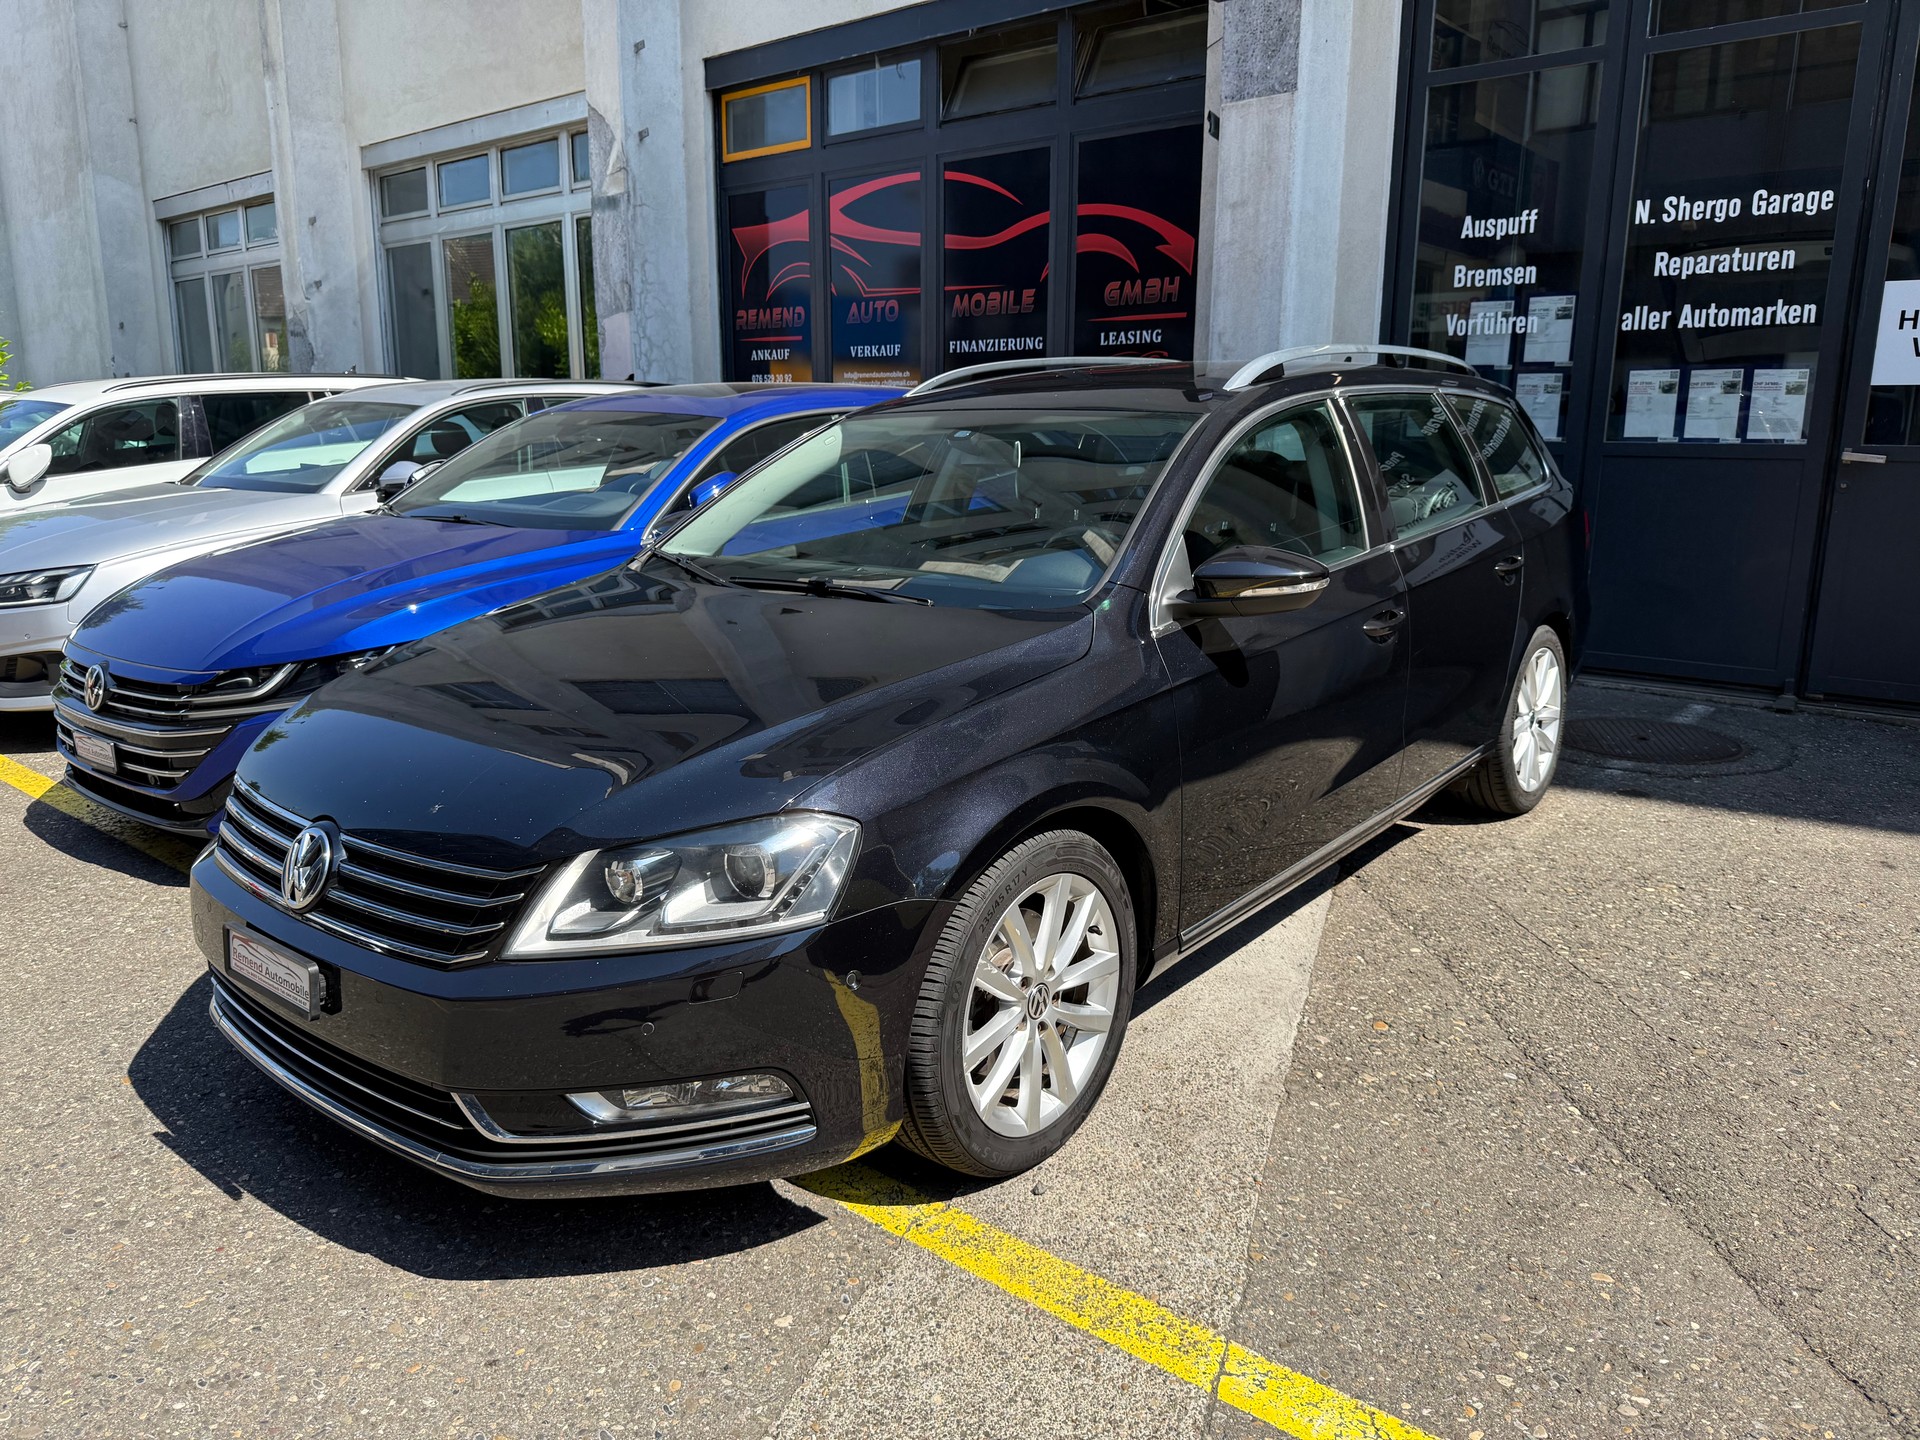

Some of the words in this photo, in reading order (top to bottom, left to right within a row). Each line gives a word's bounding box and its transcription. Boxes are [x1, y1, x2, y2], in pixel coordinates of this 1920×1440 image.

[1635, 199, 1656, 225] N.
[1662, 195, 1742, 223] Shergo
[1751, 189, 1835, 216] Garage
[1460, 208, 1539, 240] Auspuff
[1453, 264, 1537, 288] Bremsen
[1653, 247, 1796, 280] Reparaturen
[736, 306, 805, 330] REMEND
[846, 299, 899, 324] AUTO
[952, 289, 1036, 318] MOBILE
[1104, 276, 1180, 307] GMBH
[1621, 305, 1672, 332] aller
[1677, 299, 1817, 329] Automarken
[1100, 329, 1162, 346] LEASING
[1446, 311, 1539, 337] Vorführen
[751, 349, 790, 361] ANKAUF
[850, 344, 901, 358] VERKAUF
[949, 337, 1043, 354] FINANZIERUNG
[232, 946, 263, 973] Remend
[264, 966, 310, 999] Automobile
